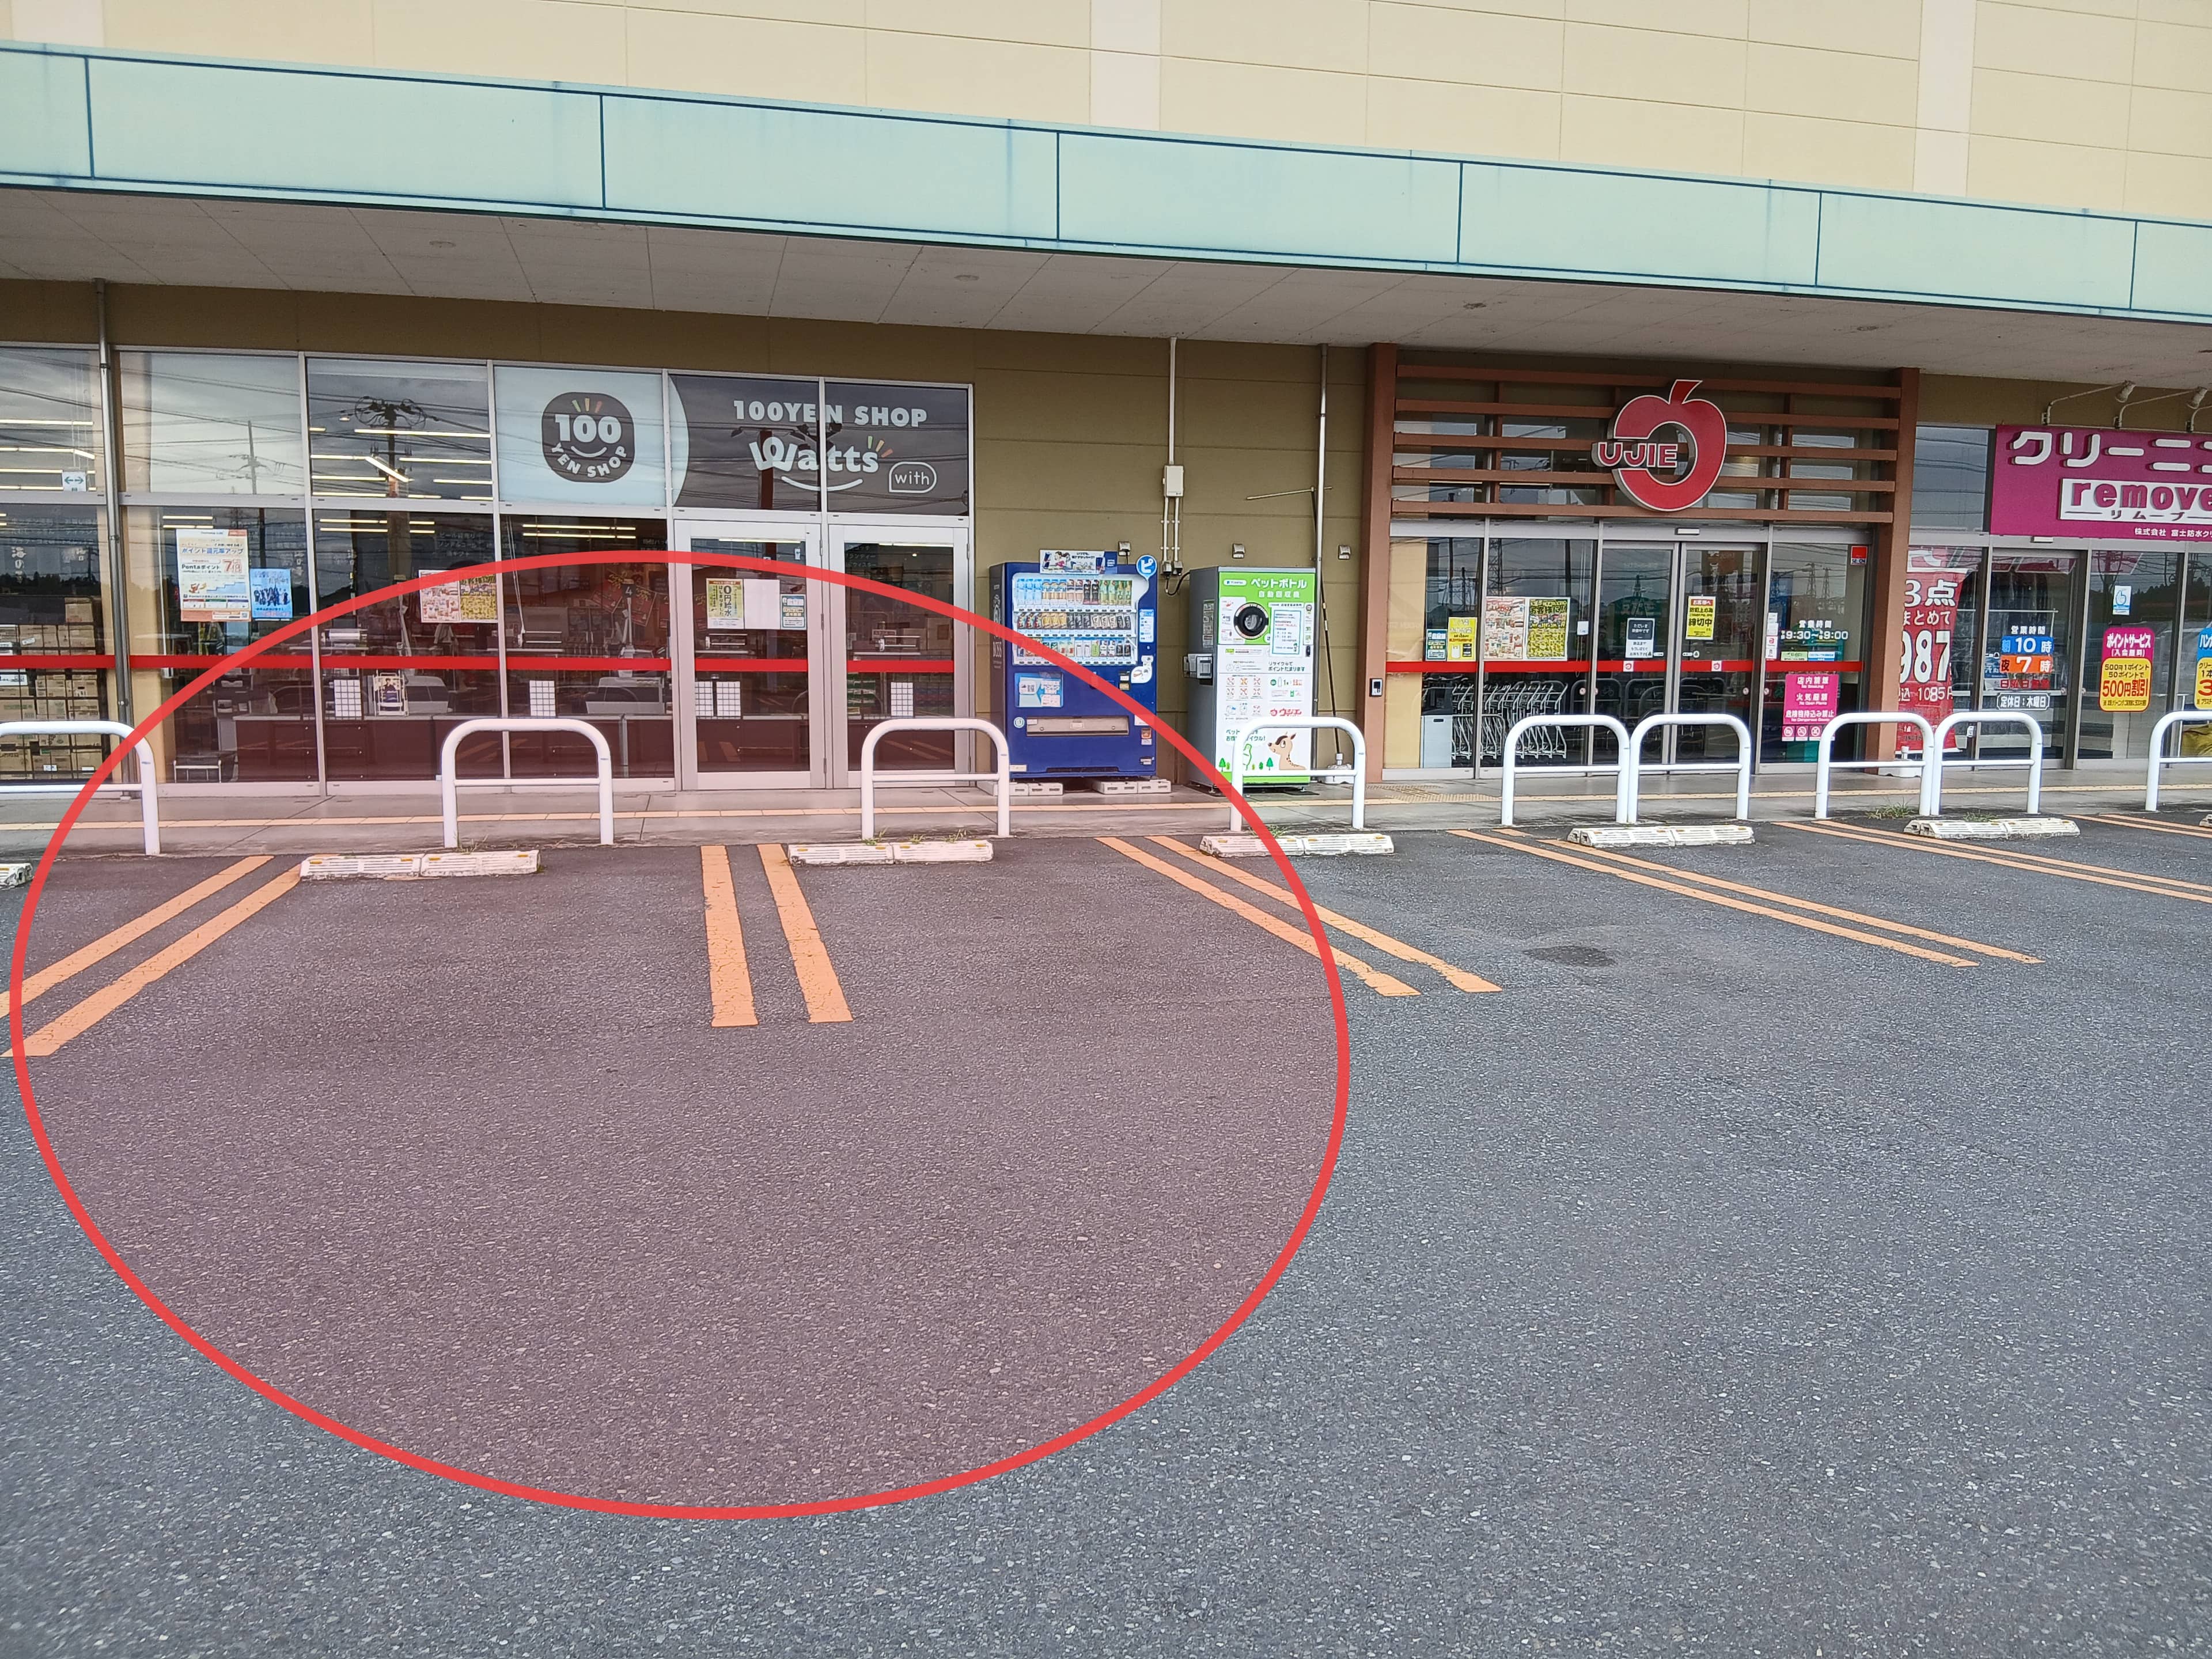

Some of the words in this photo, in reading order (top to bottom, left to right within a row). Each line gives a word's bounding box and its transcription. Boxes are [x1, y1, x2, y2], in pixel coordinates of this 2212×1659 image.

[733, 400, 843, 424] 100YEN
[854, 406, 927, 427] SHOP
[555, 414, 622, 444] 100
[551, 442, 581, 474] YEN
[587, 446, 627, 478] SHOP
[749, 436, 879, 473] Watts
[1598, 442, 1678, 468] UJIE
[895, 471, 930, 486] with
[2135, 528, 2166, 536] 株式会社
[625, 586, 632, 596] 4
[1251, 578, 1308, 589] ペットボトル
[2011, 625, 2046, 635] 営業時間
[2015, 637, 2036, 653] 10
[2107, 632, 2152, 649] ポイントサービス
[2001, 659, 2010, 672] 夜
[2016, 656, 2032, 673] 7
[2102, 679, 2148, 698] 500円割引
